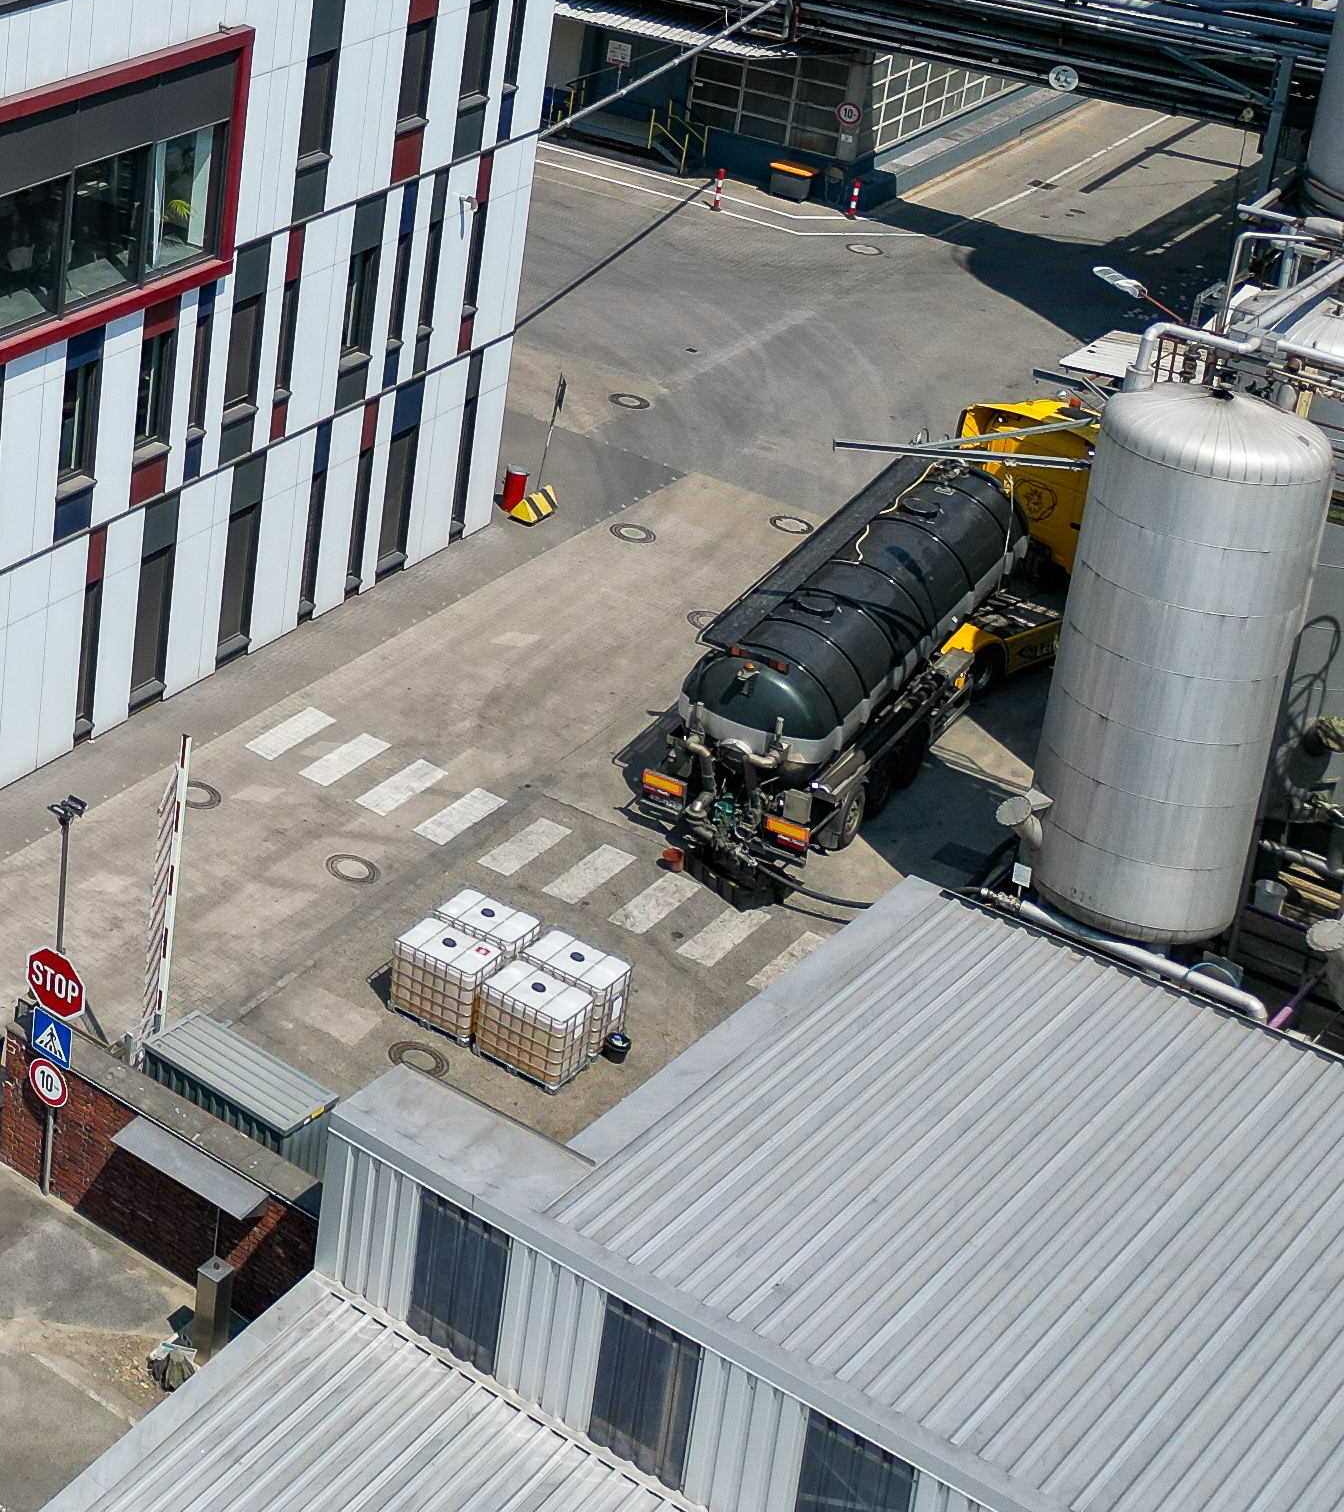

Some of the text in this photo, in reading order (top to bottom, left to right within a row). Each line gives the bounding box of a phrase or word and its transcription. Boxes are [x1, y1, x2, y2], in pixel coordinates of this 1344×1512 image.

[844, 108, 853, 119] 10
[31, 960, 79, 1004] STOP
[40, 1069, 54, 1092] 10
